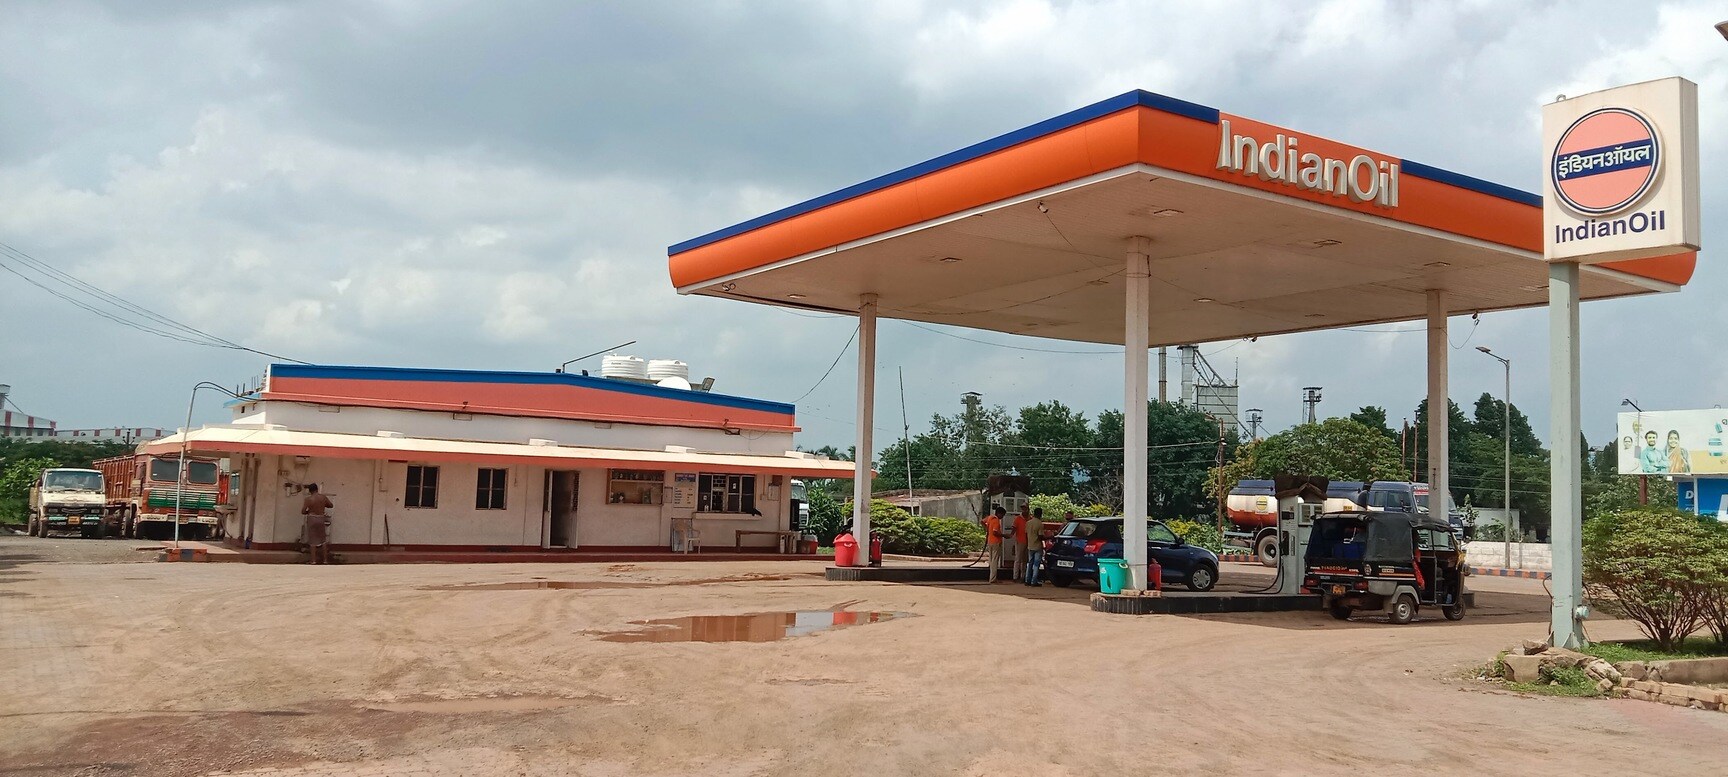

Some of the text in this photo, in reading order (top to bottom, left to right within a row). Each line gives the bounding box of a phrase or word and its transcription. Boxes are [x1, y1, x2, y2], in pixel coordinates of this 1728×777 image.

[1216, 120, 1399, 208] IndianOil
[1558, 144, 1651, 178] इंडियनऑयल
[1555, 210, 1666, 244] IndianOil
